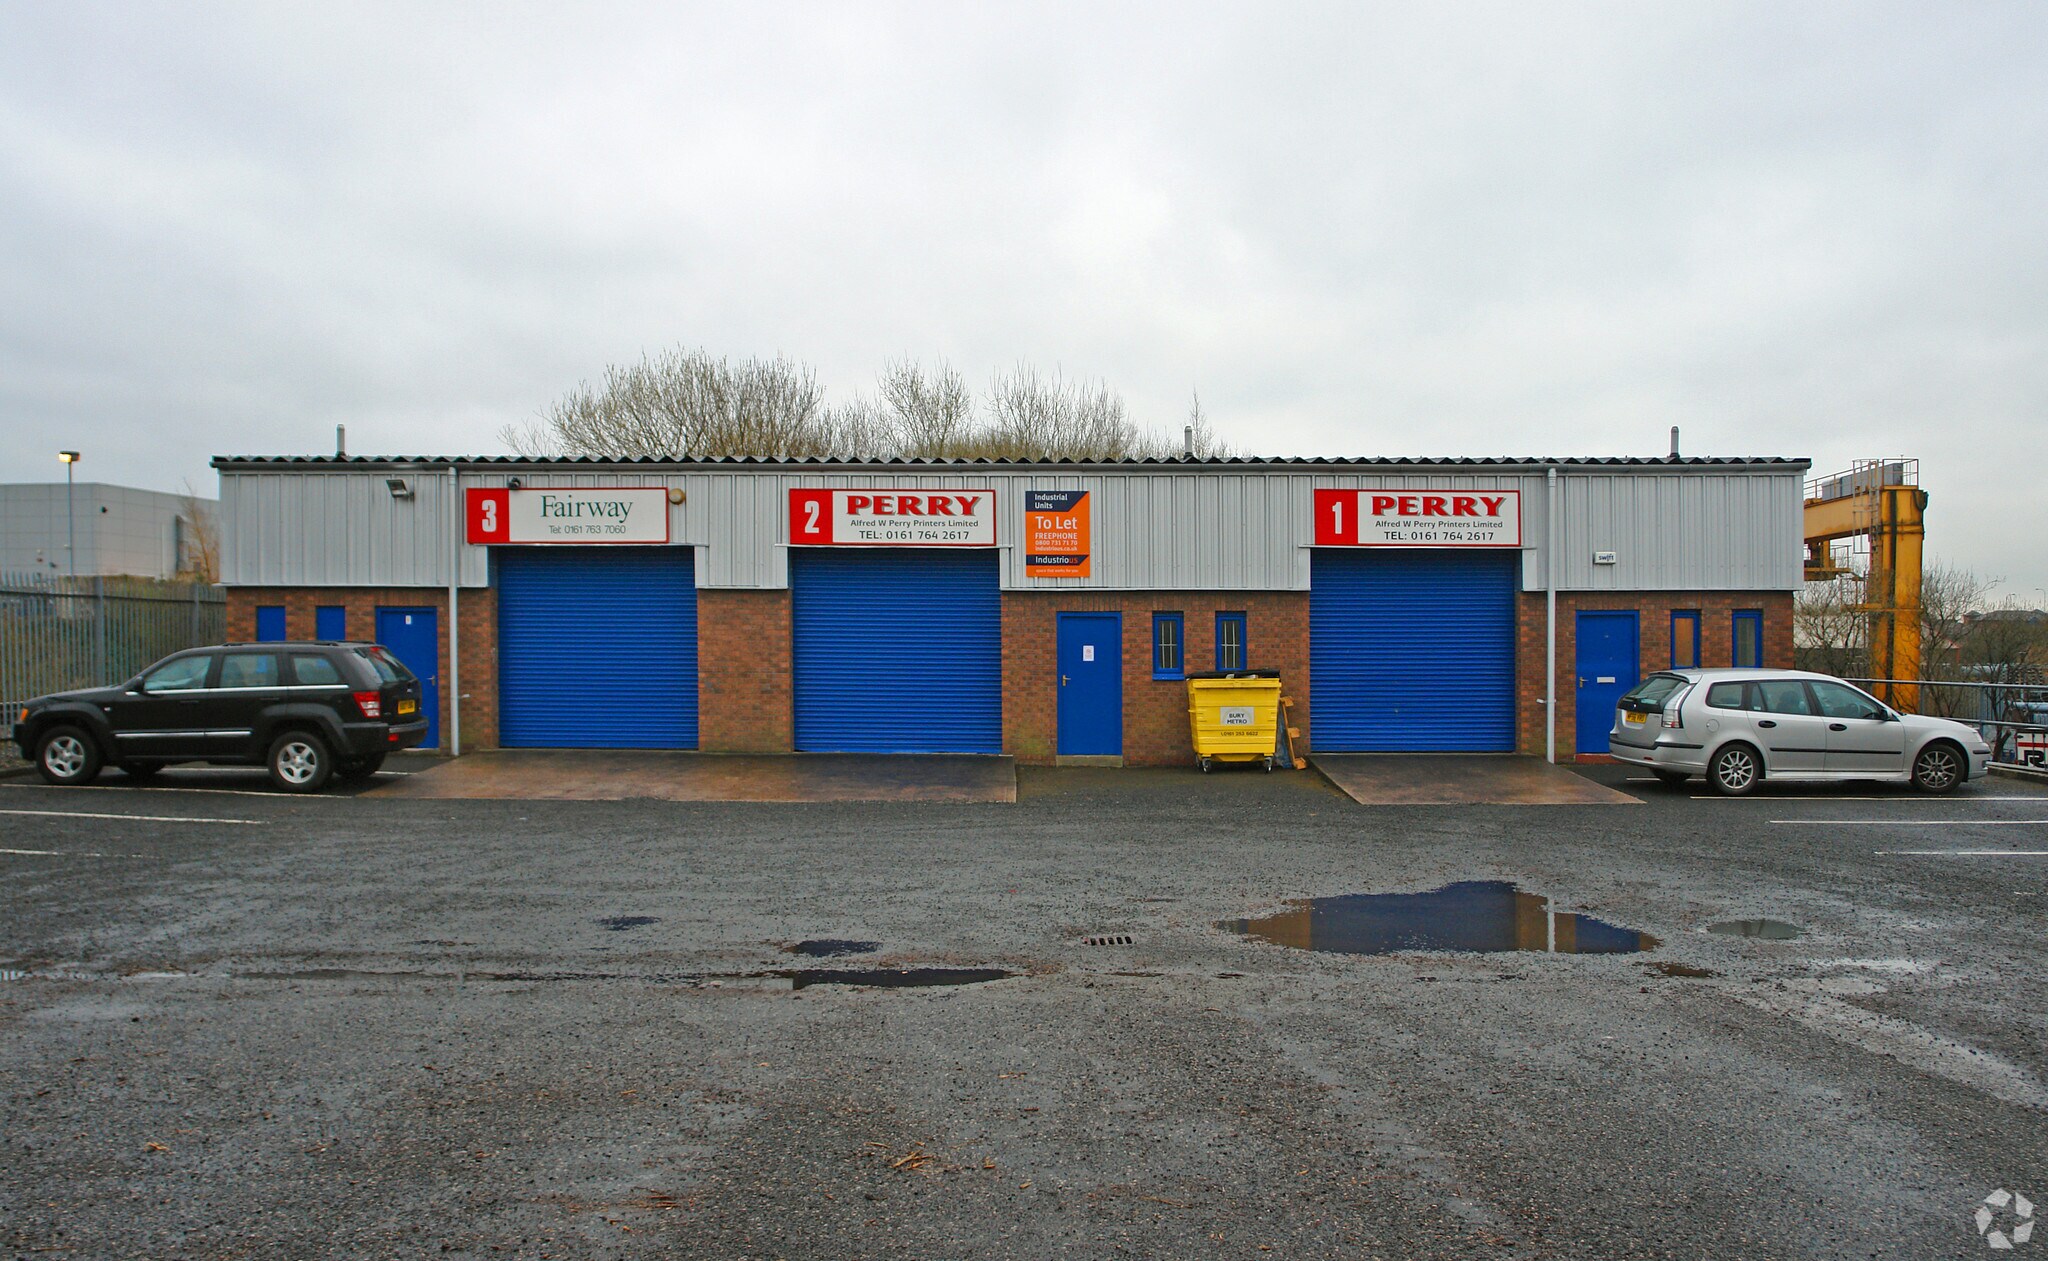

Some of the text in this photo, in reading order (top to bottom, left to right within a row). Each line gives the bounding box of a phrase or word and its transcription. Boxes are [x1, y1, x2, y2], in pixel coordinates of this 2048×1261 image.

[540, 495, 633, 524] Fairway
[846, 496, 982, 516] PERRY
[1371, 496, 1506, 517] PERRY
[481, 500, 497, 532] 3
[804, 500, 820, 534] 2
[1332, 501, 1342, 534] 1
[889, 520, 911, 528] Perry
[1035, 516, 1077, 529] To Let
[1375, 520, 1503, 529] Alfred W Perry Printers Limited
[549, 525, 626, 534] Tel: 0161 763 7060
[859, 530, 969, 540] TEL: 0161 764 2617
[1035, 532, 1077, 540] FREEPHONE
[1384, 531, 1494, 541] TEL: 0161 764 2617
[1036, 556, 1078, 564] Industrious
